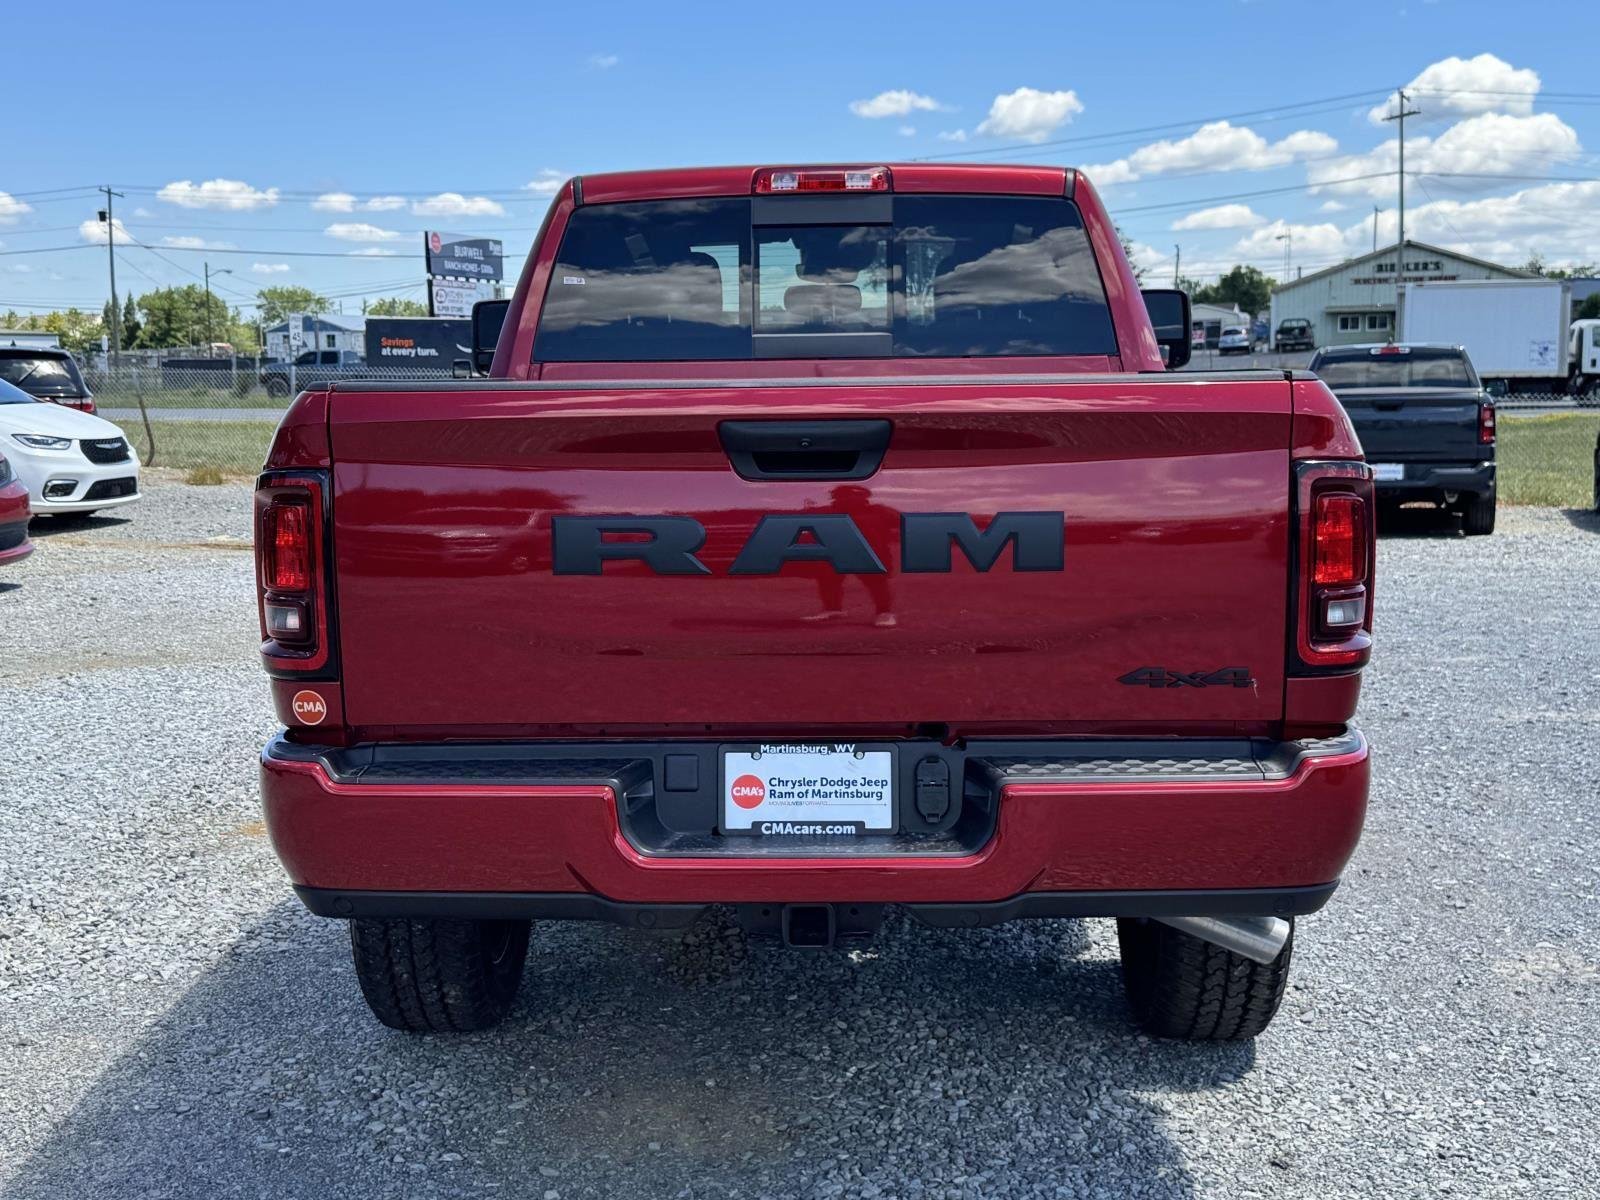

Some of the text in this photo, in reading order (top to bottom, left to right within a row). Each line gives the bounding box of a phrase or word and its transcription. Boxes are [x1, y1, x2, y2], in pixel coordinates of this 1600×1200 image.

[454, 246, 483, 258] BURWELL
[444, 260, 461, 271] RANCH
[462, 262, 478, 272] HOMES
[1376, 262, 1441, 272] BIELER'S
[381, 337, 414, 348] Savings
[381, 347, 439, 358] at every turn.
[552, 511, 1064, 575] RAM
[1116, 666, 1249, 688] 4x4
[294, 701, 324, 713] CMA
[760, 744, 856, 755] Martinsburg, WV
[768, 777, 888, 789] Chrysler Dodge Jeep
[732, 787, 764, 797] CMA's
[769, 788, 883, 801] Ram of Martinsburg
[761, 822, 856, 835] CMAcars.com
